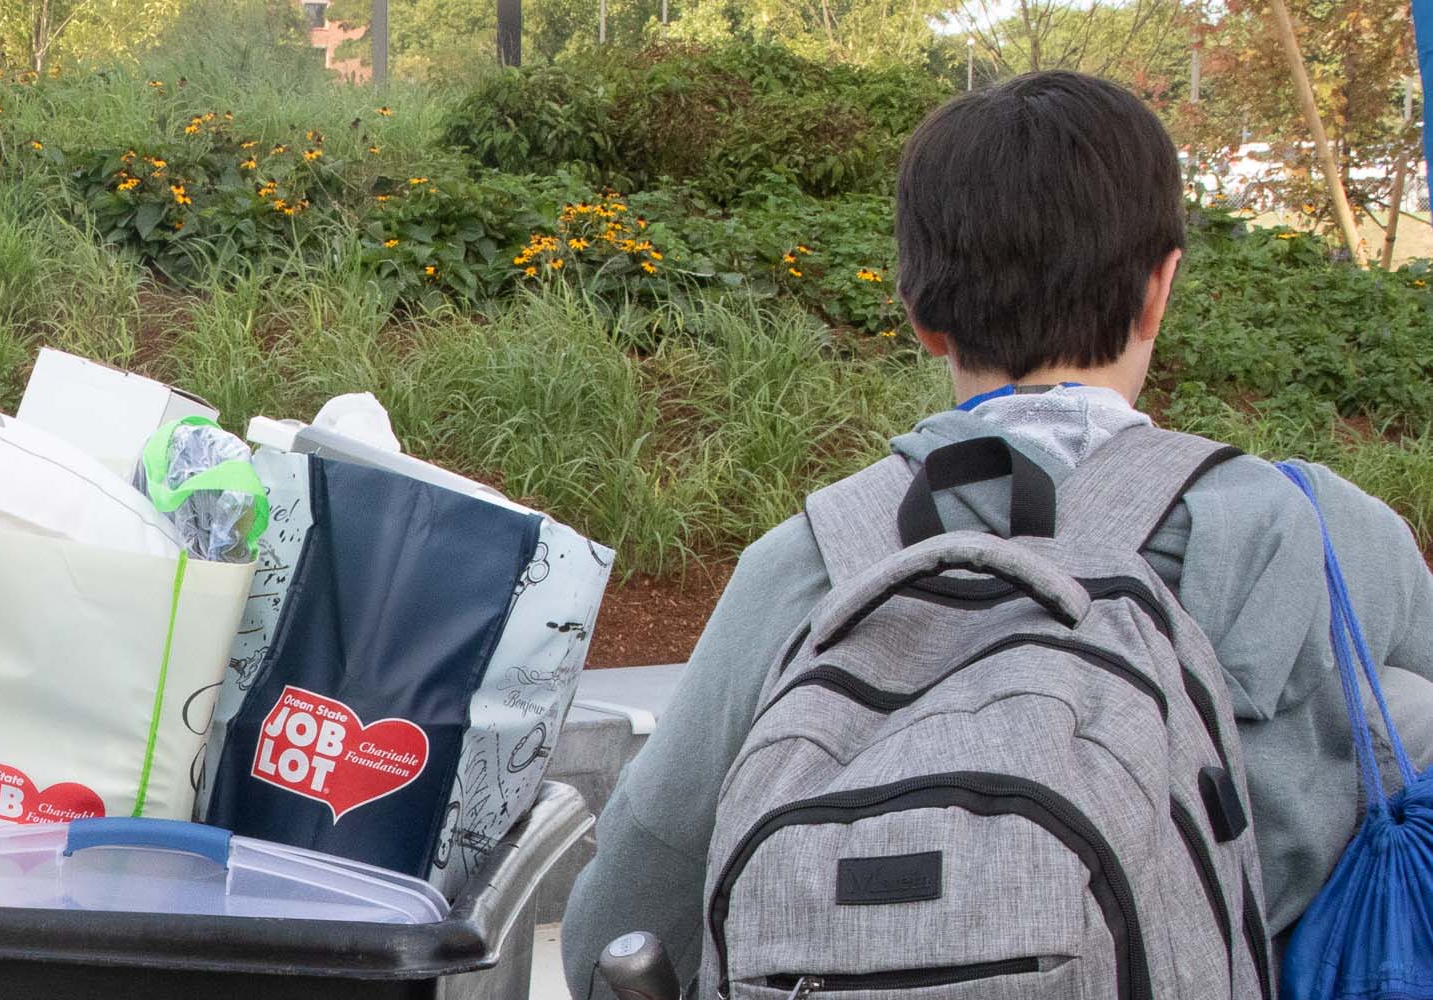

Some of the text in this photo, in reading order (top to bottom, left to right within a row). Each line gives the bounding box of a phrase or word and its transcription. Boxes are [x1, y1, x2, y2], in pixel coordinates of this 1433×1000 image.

[283, 693, 349, 723] Ocean State
[504, 689, 545, 719] Bonjour
[264, 706, 347, 757] JOB
[257, 738, 336, 793] LOT
[344, 750, 411, 778] Foundation
[358, 741, 419, 767] Charitable
